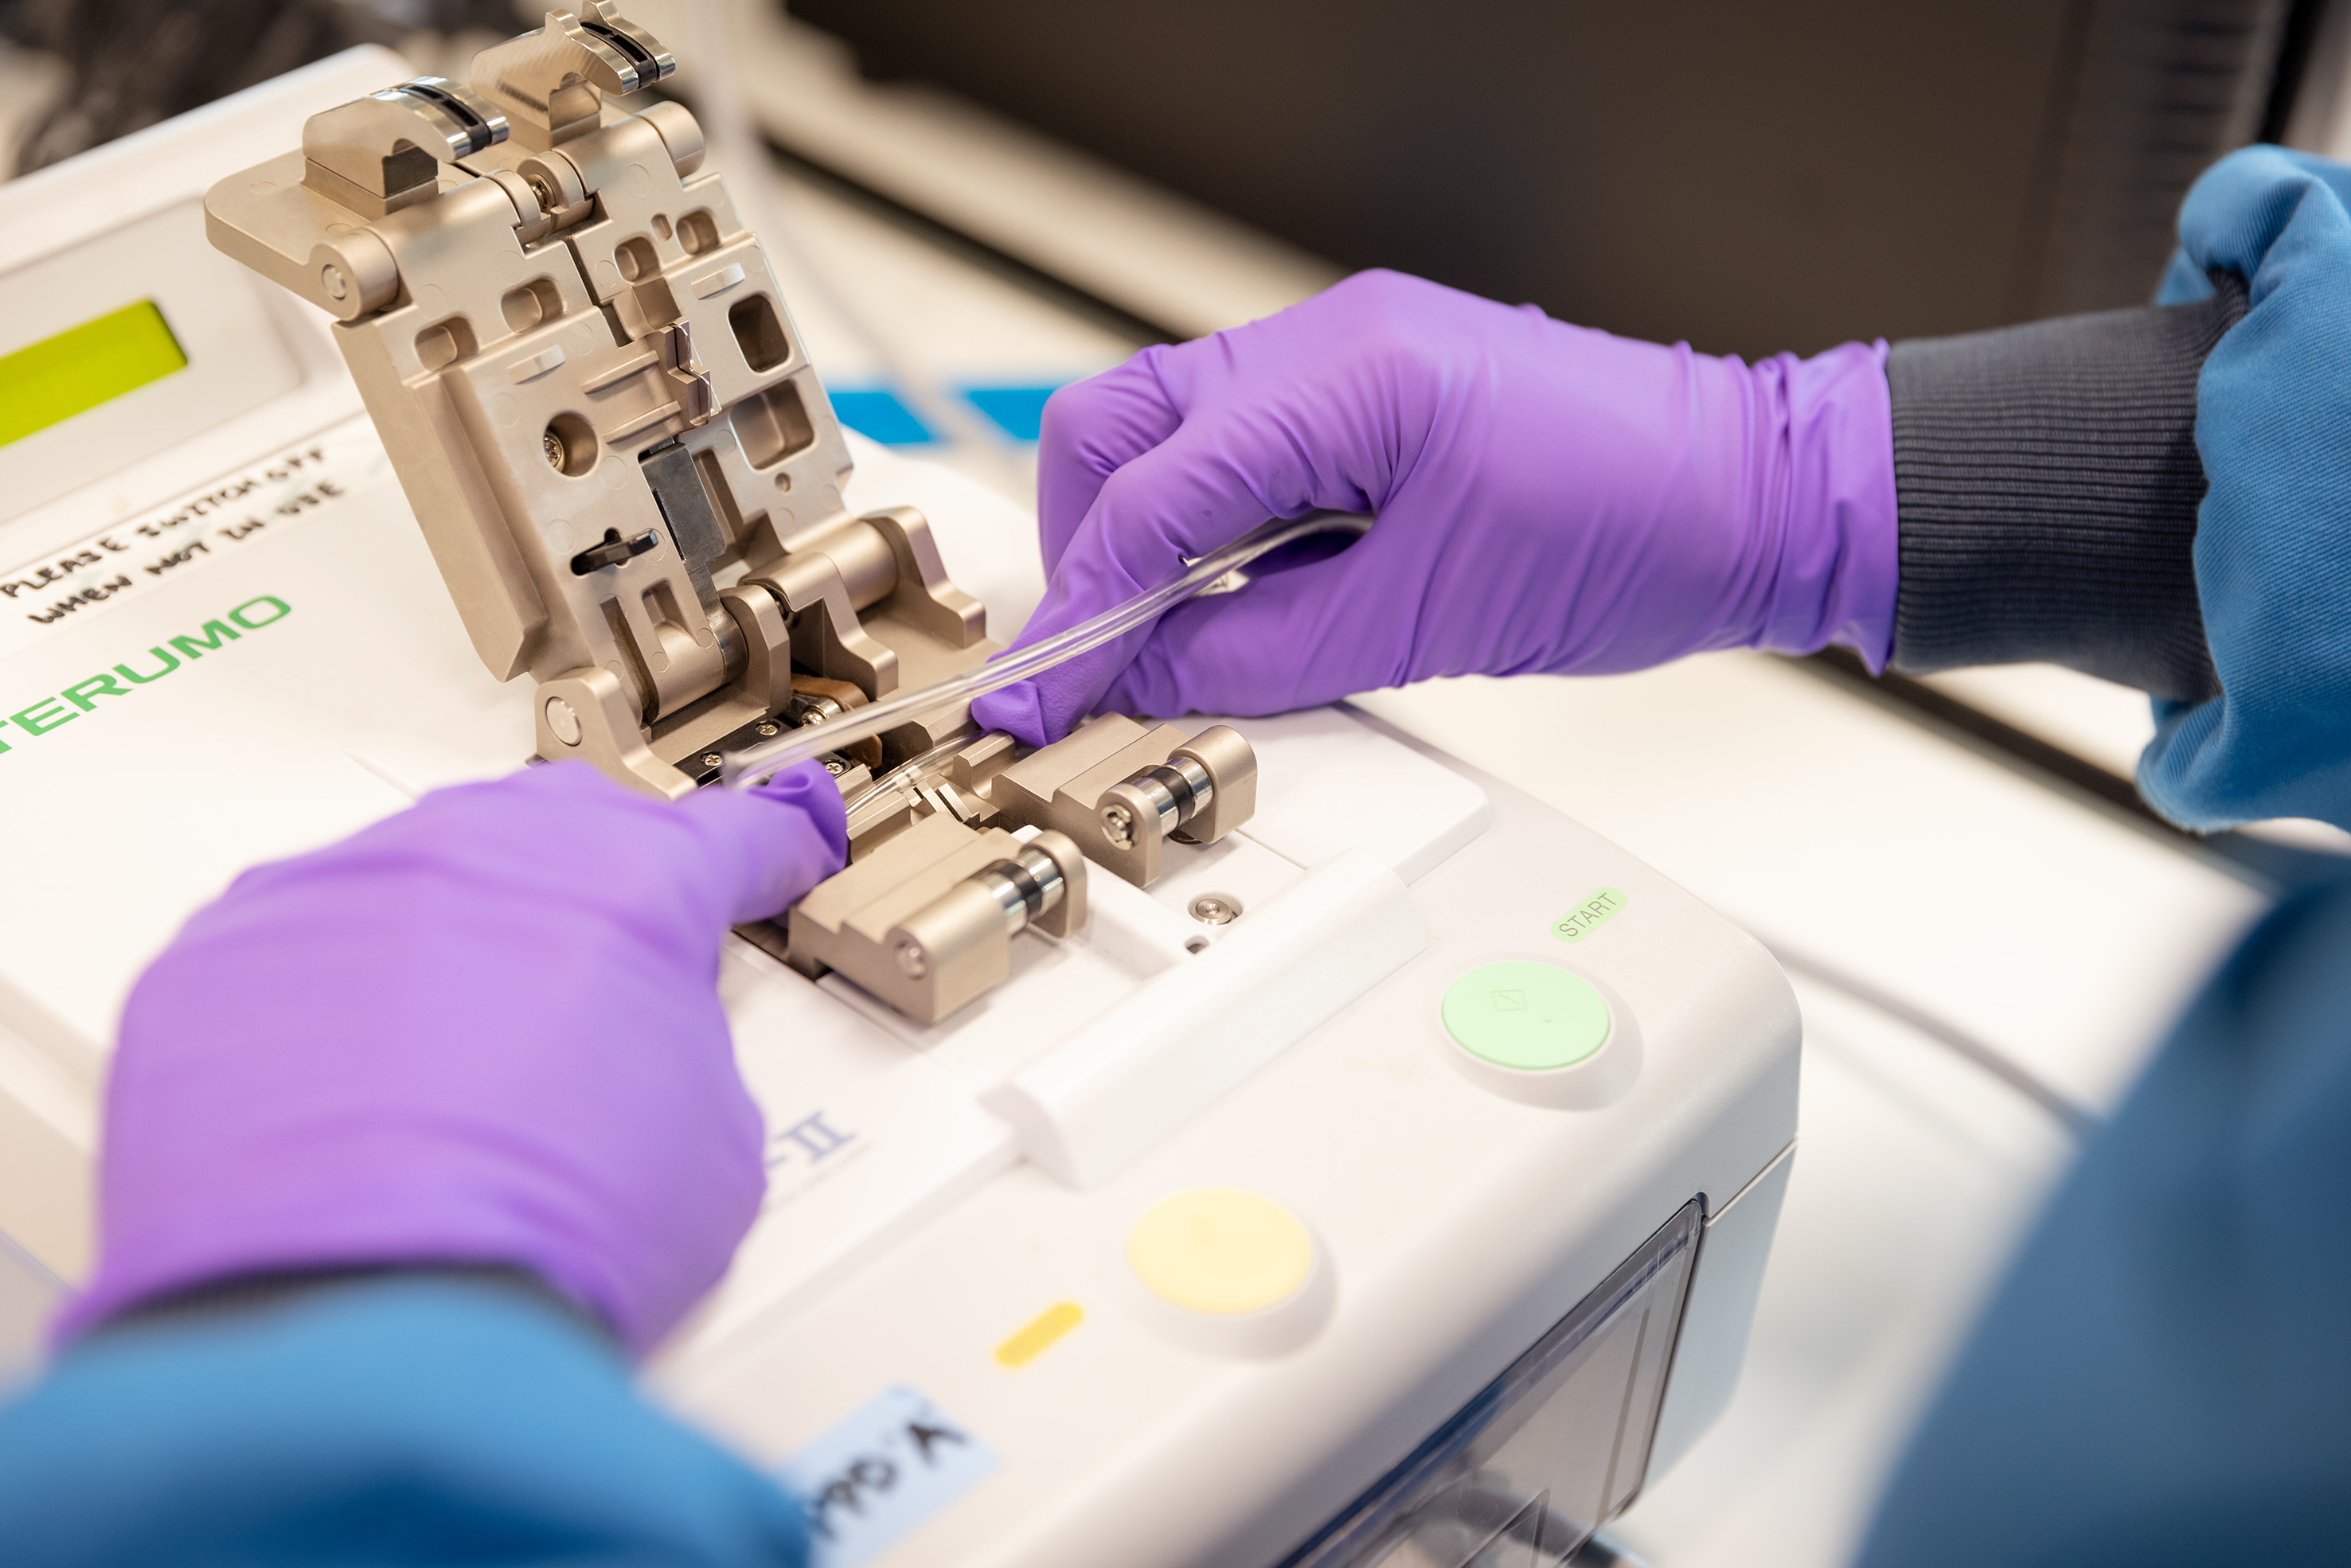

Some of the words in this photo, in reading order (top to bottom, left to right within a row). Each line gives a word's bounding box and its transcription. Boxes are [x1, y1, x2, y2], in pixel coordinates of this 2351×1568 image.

[0, 536, 131, 599] PLEASE
[135, 479, 262, 538] SWITCH
[264, 447, 324, 482] OFF
[26, 575, 133, 624] WHEN
[142, 540, 211, 575] NOT
[216, 517, 266, 540] IN
[274, 482, 346, 516] USE
[1558, 892, 1617, 937] START
